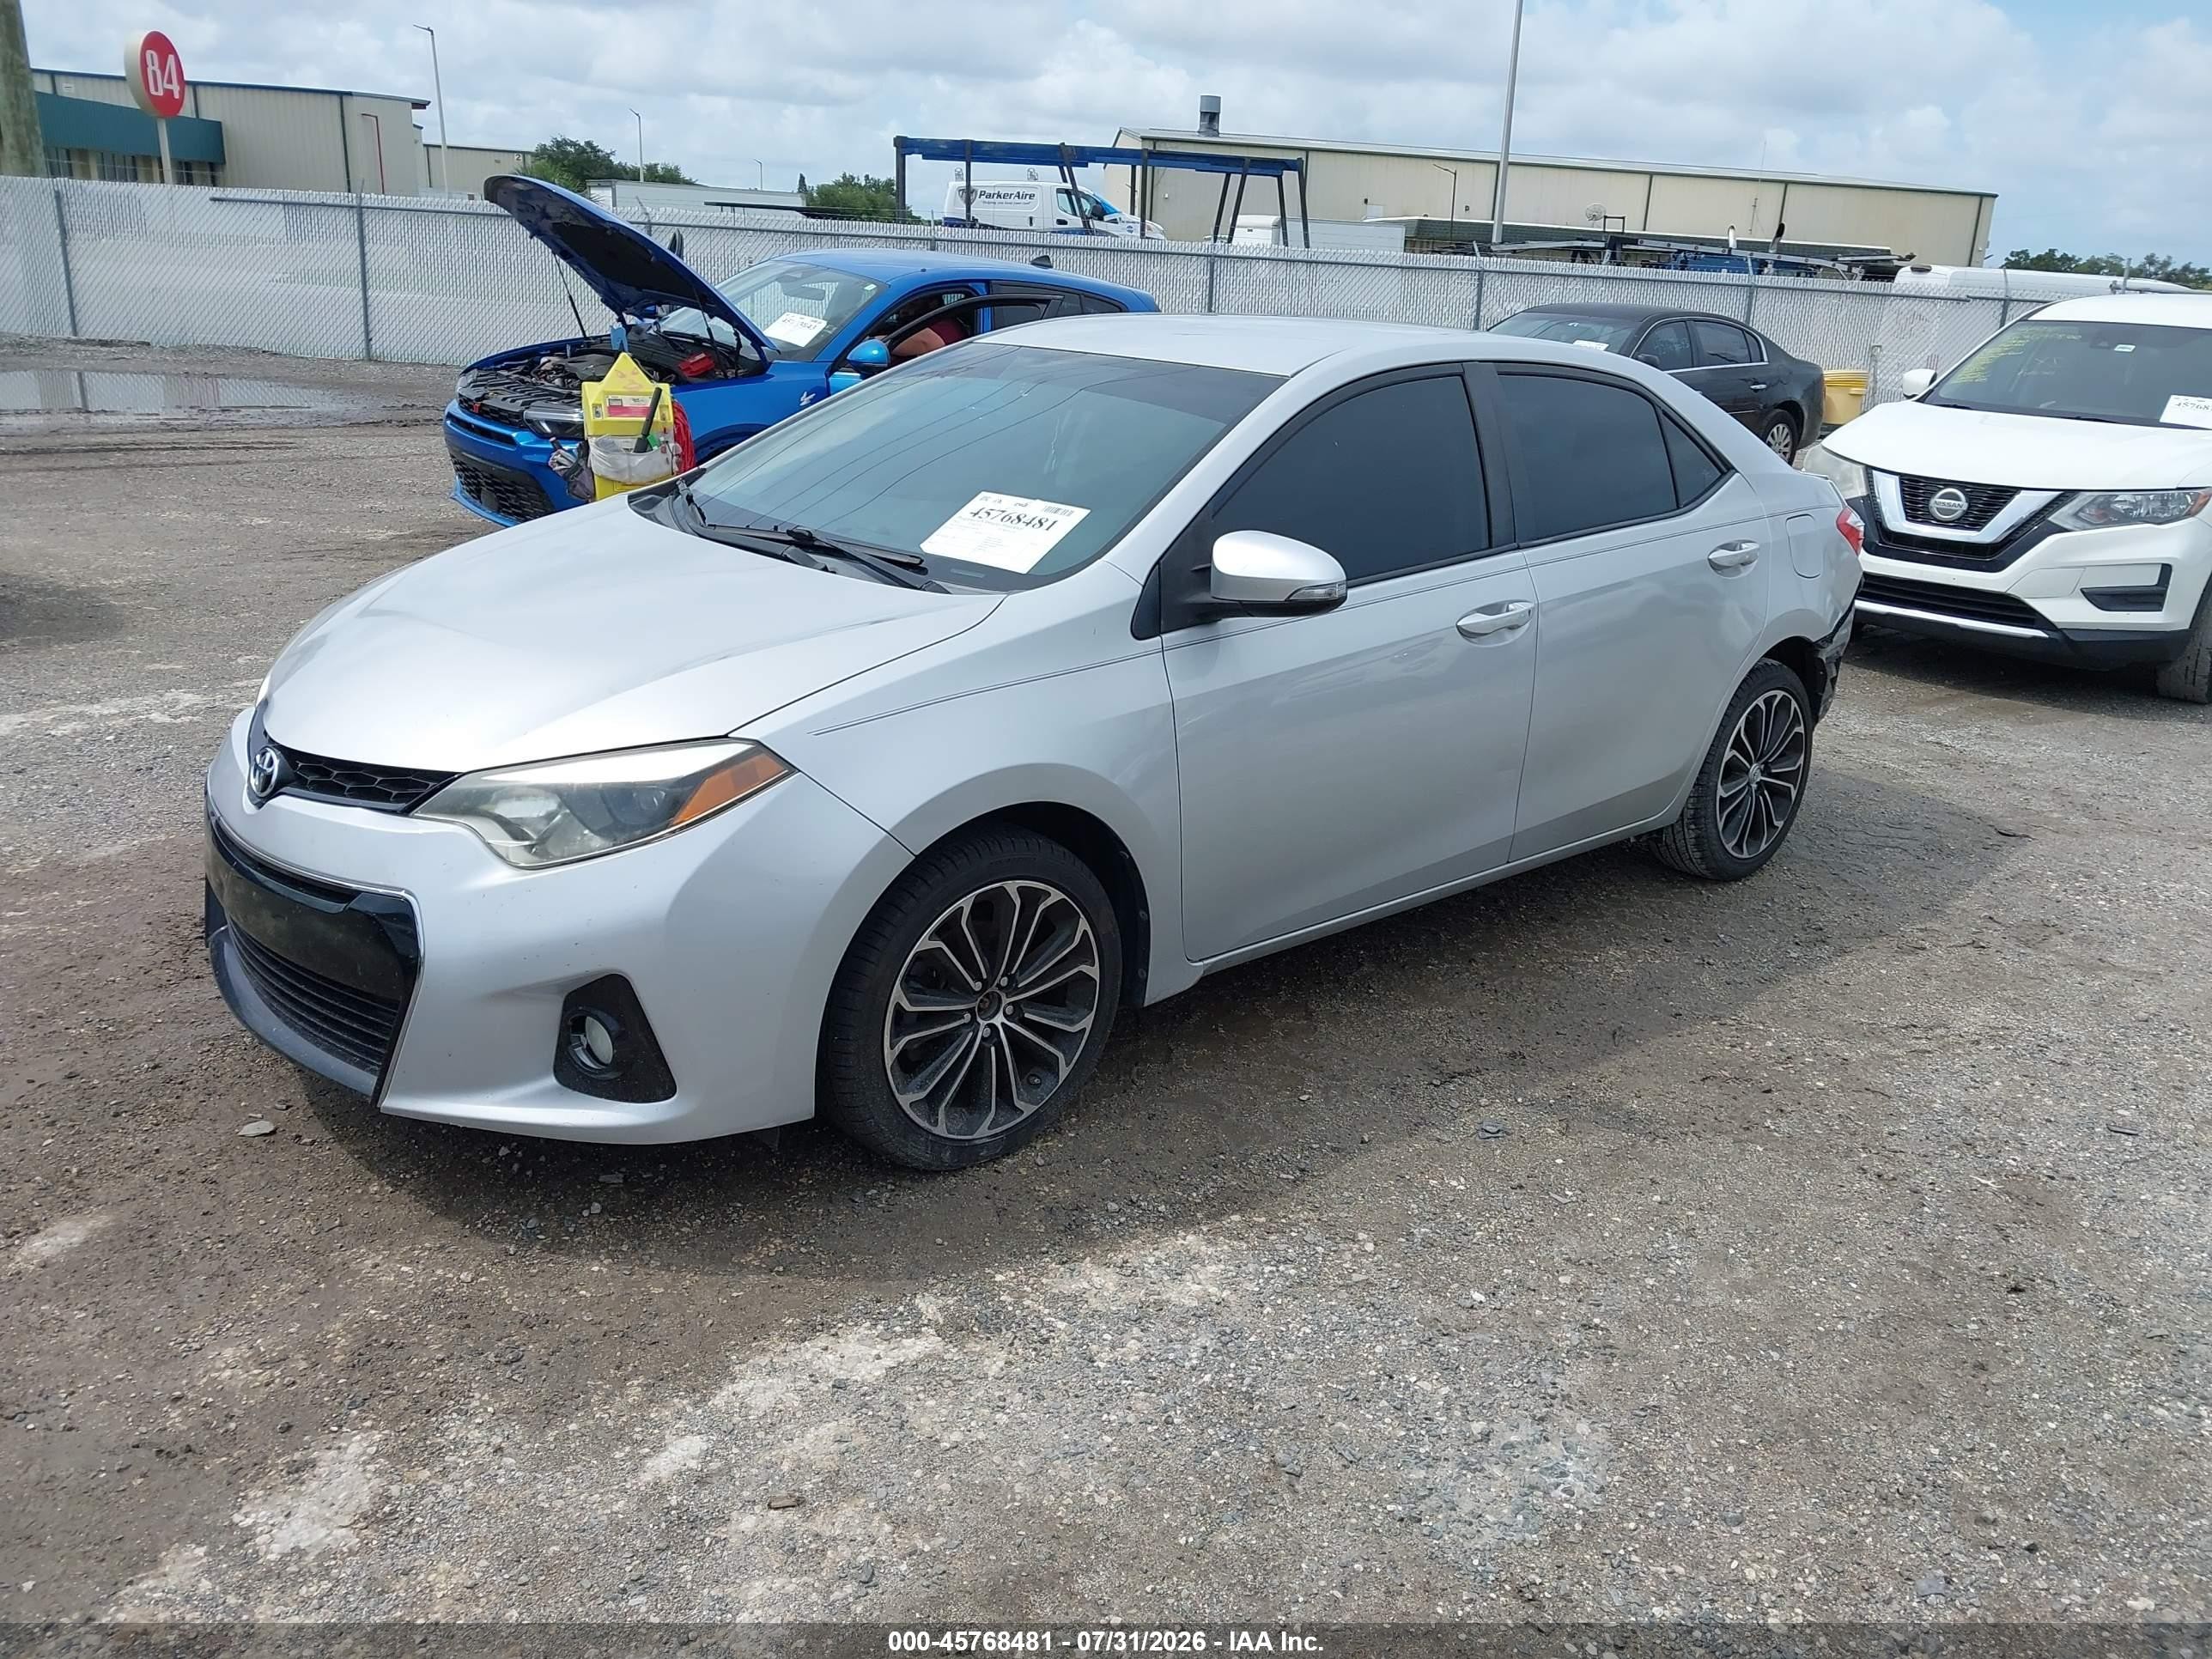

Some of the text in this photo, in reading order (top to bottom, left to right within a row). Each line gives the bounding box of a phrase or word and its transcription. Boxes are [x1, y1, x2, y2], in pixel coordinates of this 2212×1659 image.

[145, 50, 179, 100] 84
[978, 190, 1036, 200] ParkerAire
[1935, 500, 1964, 508] NISSAN
[969, 507, 1058, 531] 45768481
